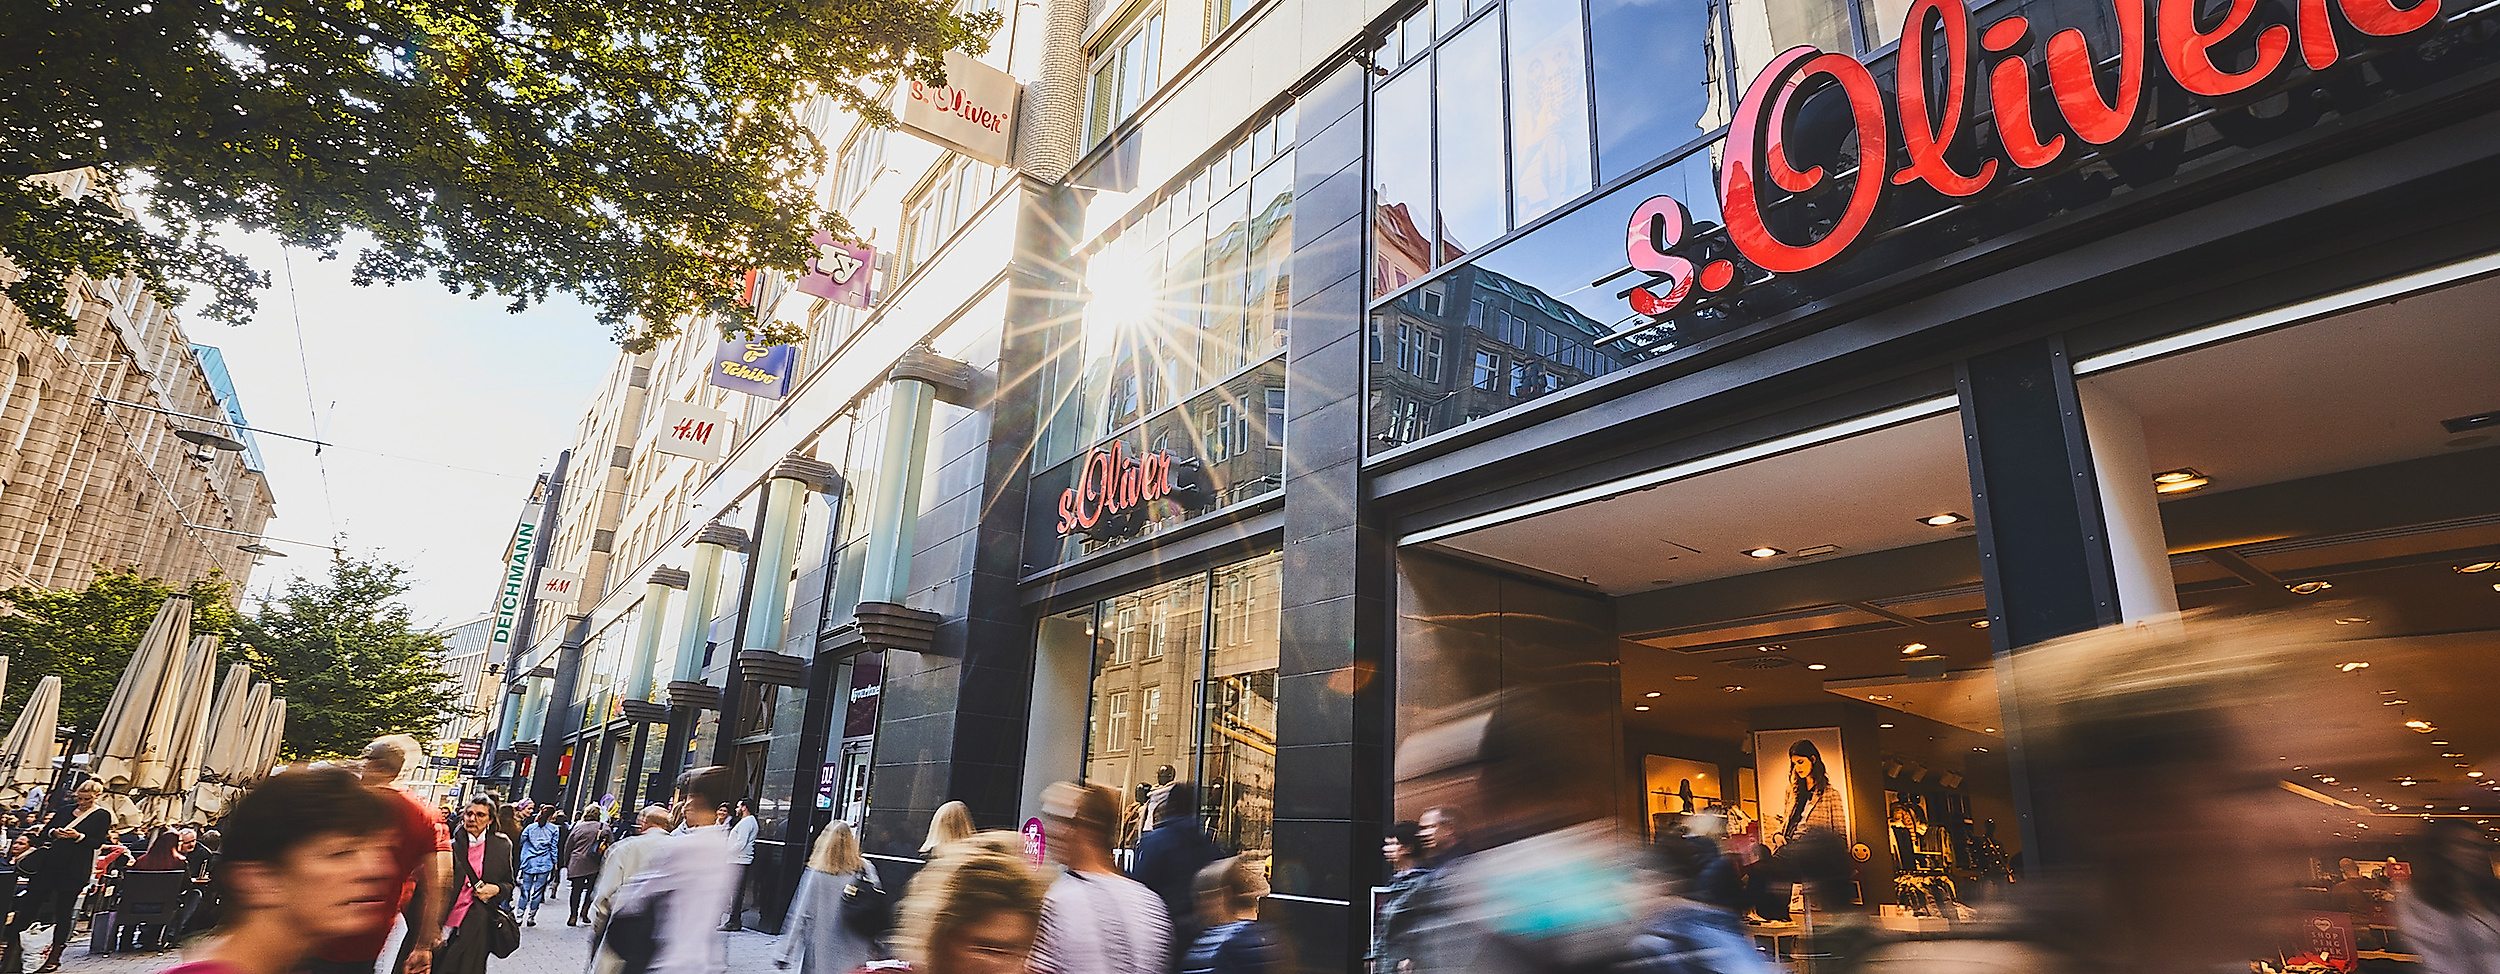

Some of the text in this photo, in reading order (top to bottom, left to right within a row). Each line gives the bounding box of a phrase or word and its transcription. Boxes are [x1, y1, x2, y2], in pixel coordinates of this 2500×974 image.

[720, 360, 780, 385] Tchibo
[671, 417, 714, 446] H&M
[1056, 439, 1172, 534] s.Oliver
[493, 522, 536, 644] DEICHMANN
[544, 577, 571, 594] H&M
